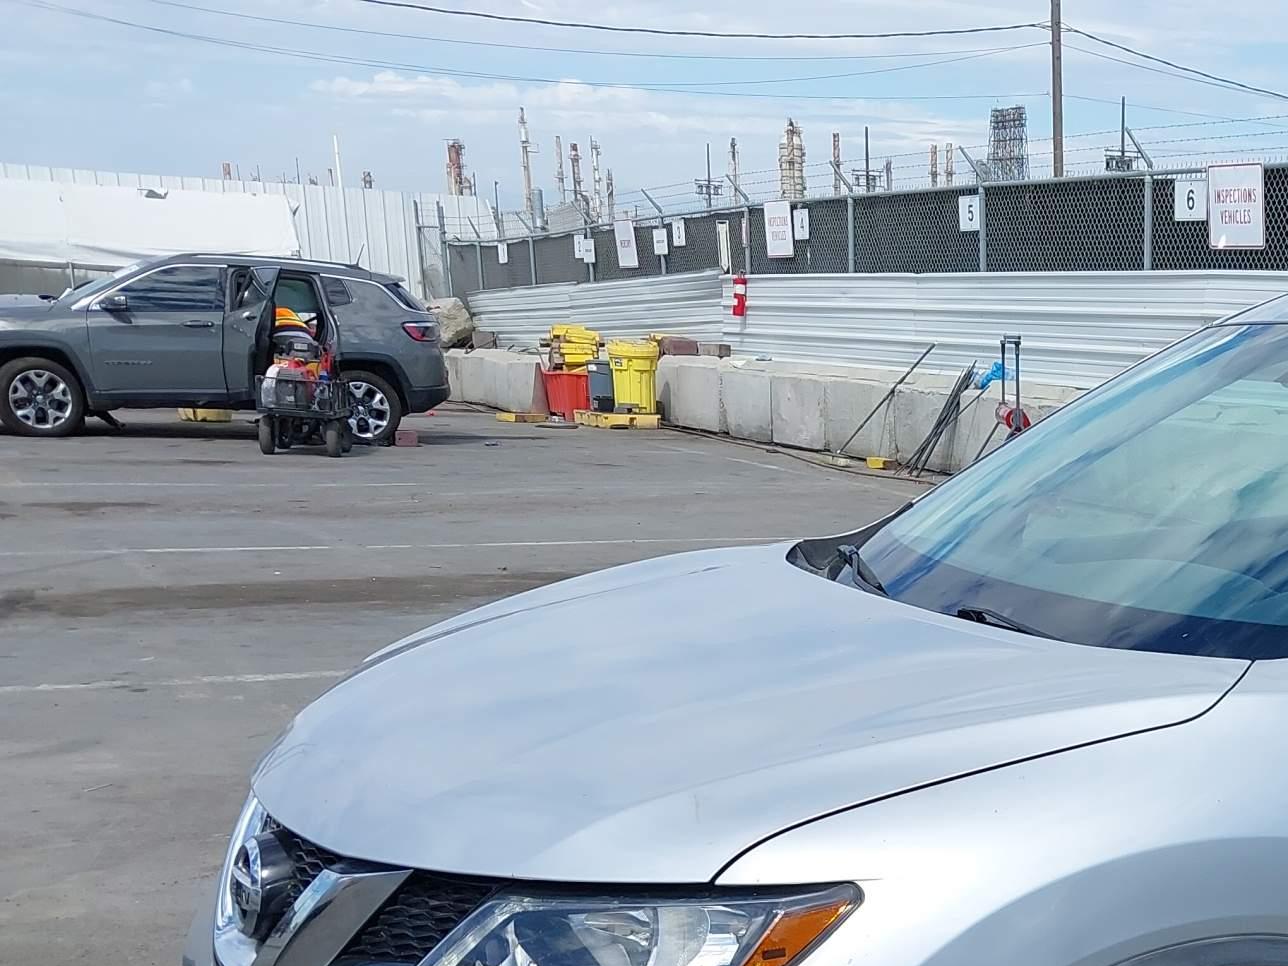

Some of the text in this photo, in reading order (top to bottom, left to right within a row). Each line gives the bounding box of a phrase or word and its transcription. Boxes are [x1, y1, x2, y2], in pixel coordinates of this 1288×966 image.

[1186, 189, 1195, 211] 6
[1214, 188, 1257, 204] INSPECTIONS
[967, 204, 974, 221] 5
[1220, 209, 1252, 224] VEHICLES
